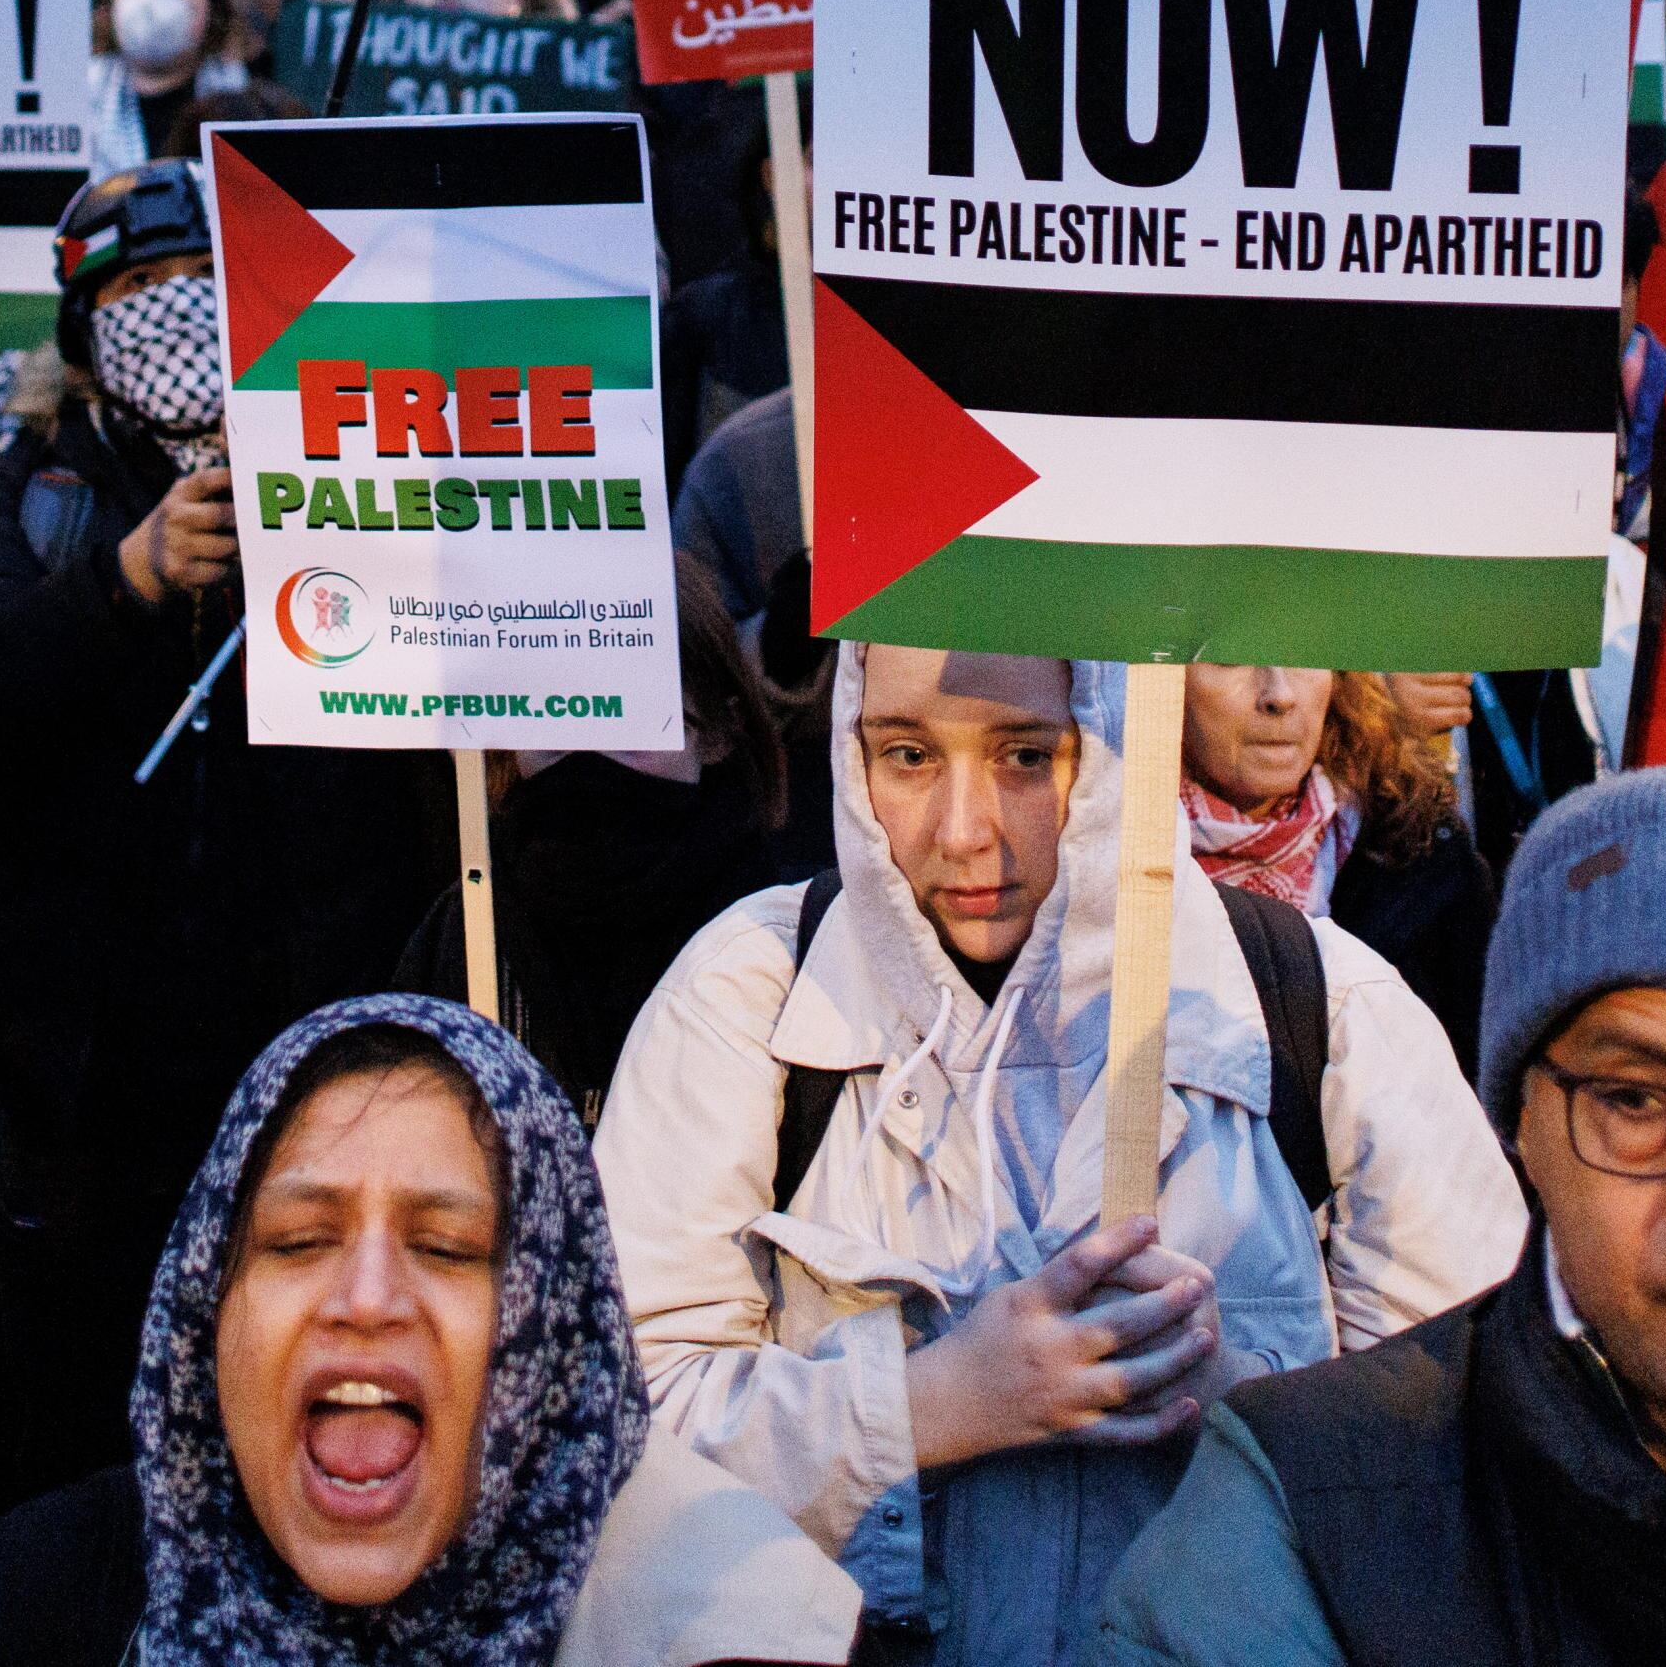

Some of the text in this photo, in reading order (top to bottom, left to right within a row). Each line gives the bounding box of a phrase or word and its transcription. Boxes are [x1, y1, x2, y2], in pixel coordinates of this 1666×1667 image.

[561, 34, 623, 92] WE
[835, 190, 935, 256] FREE
[949, 199, 1186, 268] PALESTINE
[1236, 210, 1326, 272] END
[1340, 213, 1603, 280] APARTHEID
[297, 359, 596, 461] FREE
[256, 471, 646, 532] PALESTINE
[389, 595, 653, 626] المنتدى الفلسطيني في بريطانيا
[390, 625, 654, 649] Palestinian Forum in Britain
[319, 690, 624, 719] WWW.PFBUK.COM
